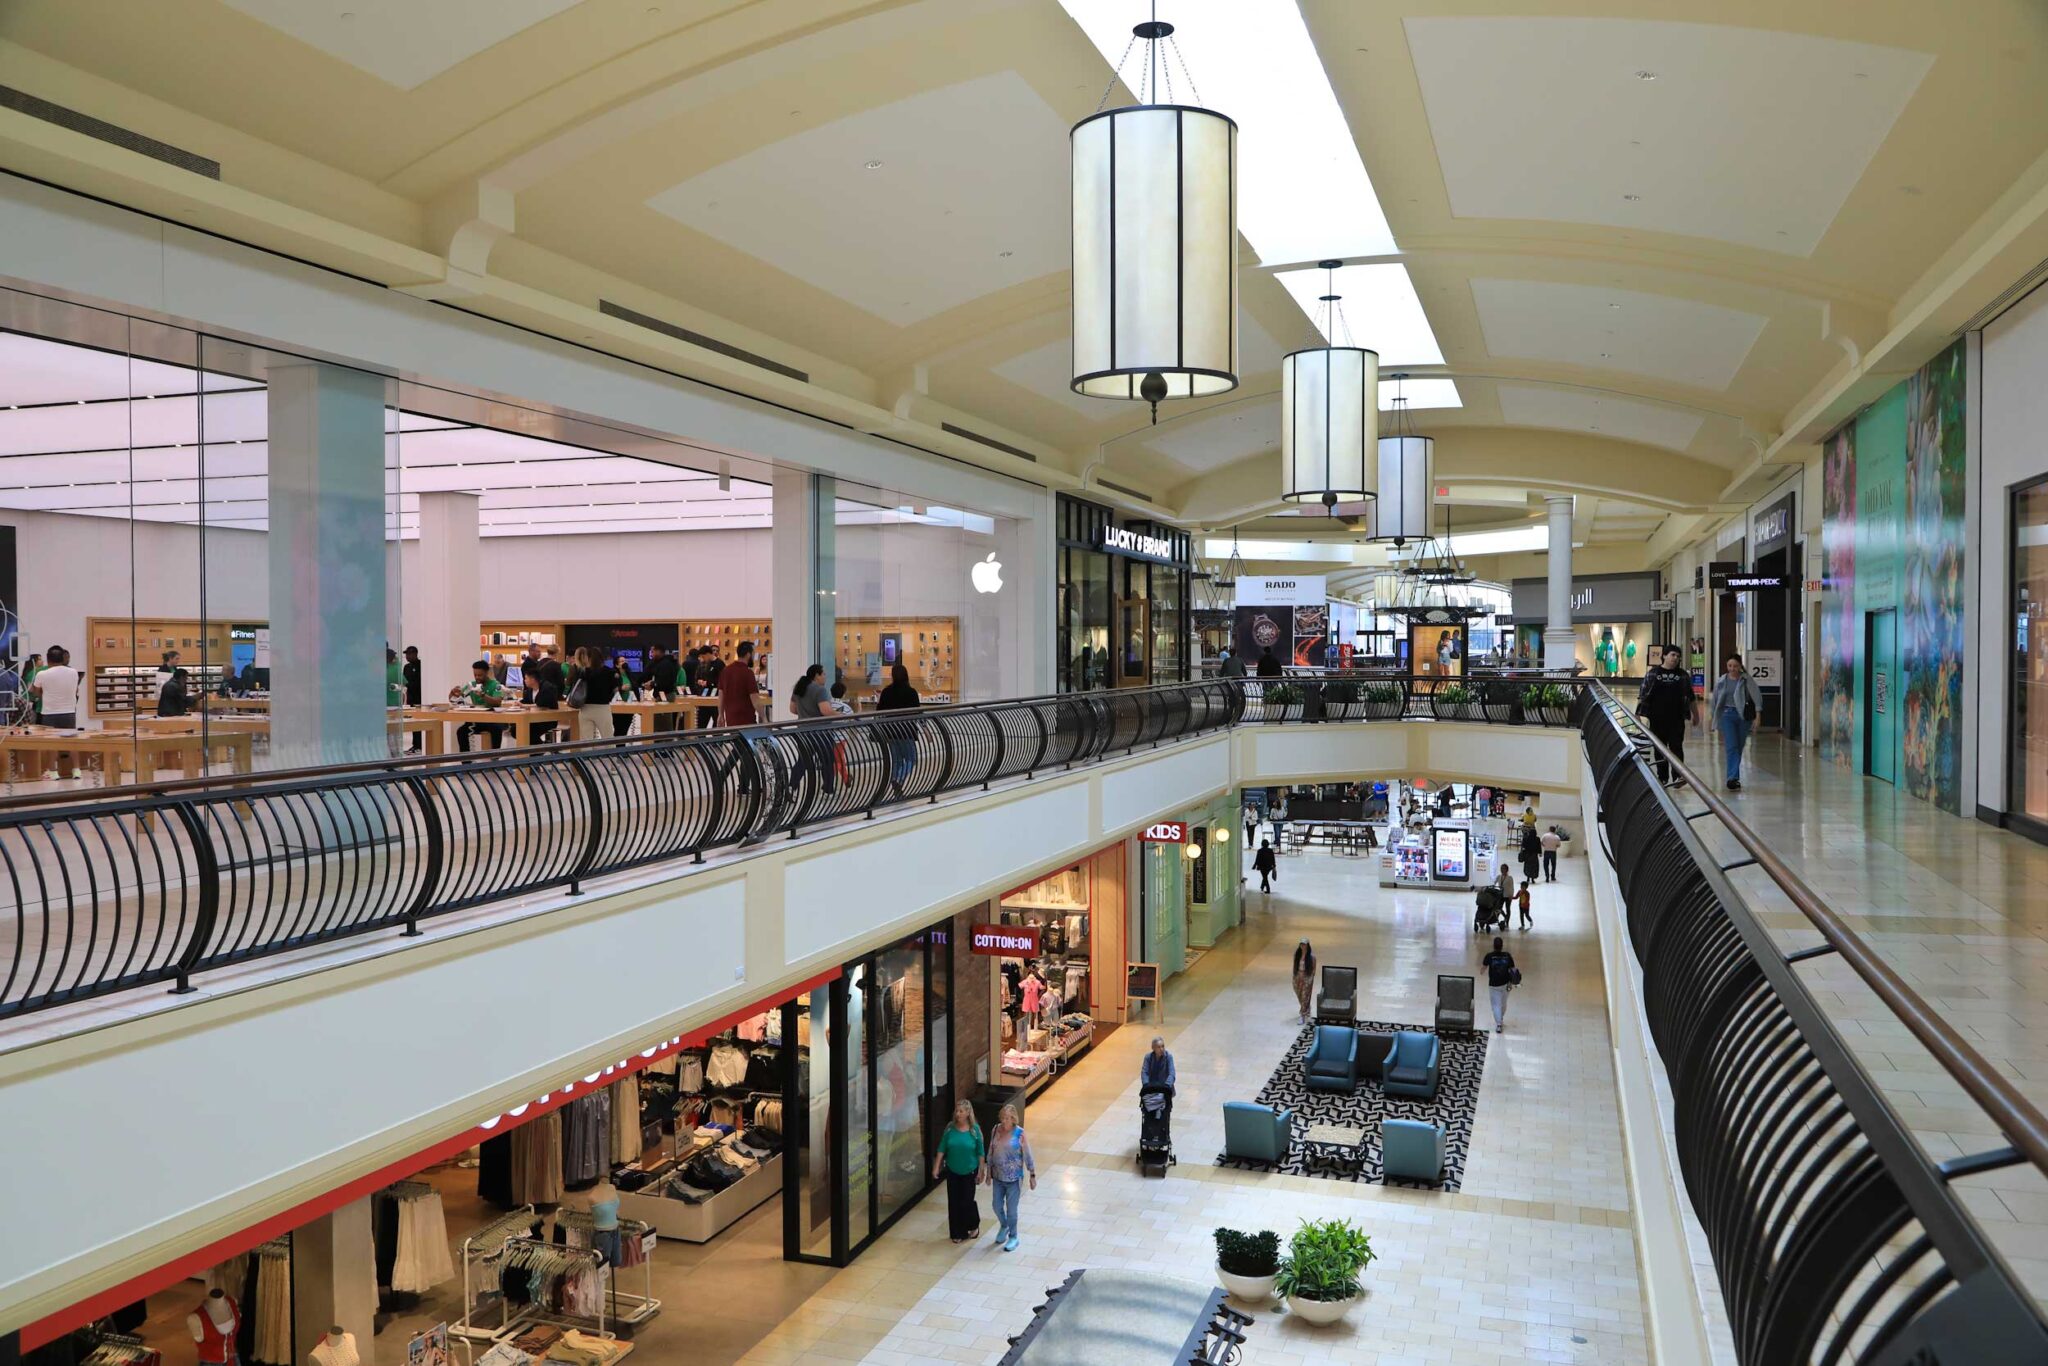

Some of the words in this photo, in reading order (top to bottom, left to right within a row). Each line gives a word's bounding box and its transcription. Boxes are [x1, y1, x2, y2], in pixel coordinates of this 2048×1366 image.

[1105, 525, 1137, 551] LUCKY
[1143, 535, 1170, 558] BRAND
[1265, 581, 1296, 589] RADO
[1727, 578, 1781, 587] TEMPUR-PEDIC
[1806, 582, 1822, 592] EXIT
[1146, 824, 1181, 840] KIDS
[974, 934, 1033, 950] COTTON:ON
